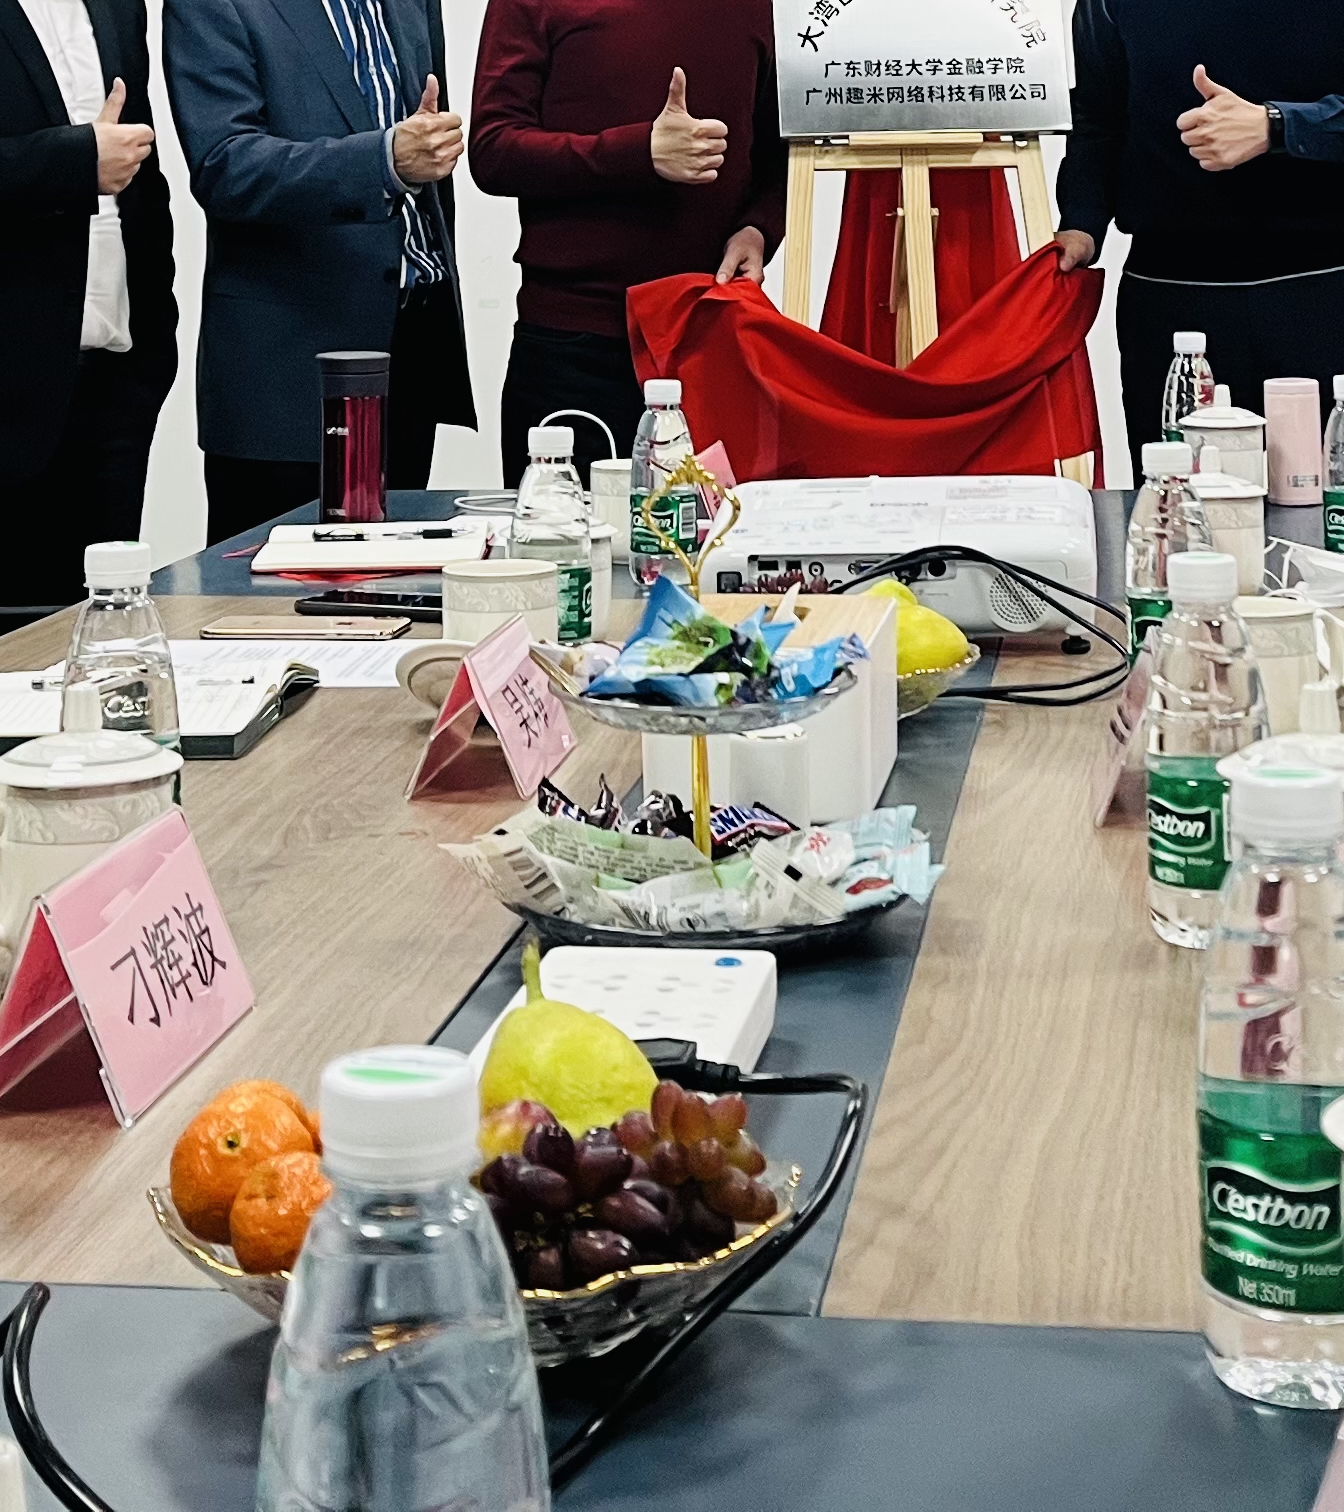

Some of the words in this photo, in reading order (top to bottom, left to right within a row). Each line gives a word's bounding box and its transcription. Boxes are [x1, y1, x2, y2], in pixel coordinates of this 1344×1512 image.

[824, 57, 1026, 78] 广东财经大学金融学院
[805, 83, 1047, 105] 广州趣米网络科技有限公司
[110, 891, 227, 1028] 刁辉波
[1246, 1252, 1299, 1278] Drinking
[1302, 1263, 1344, 1277] Water
